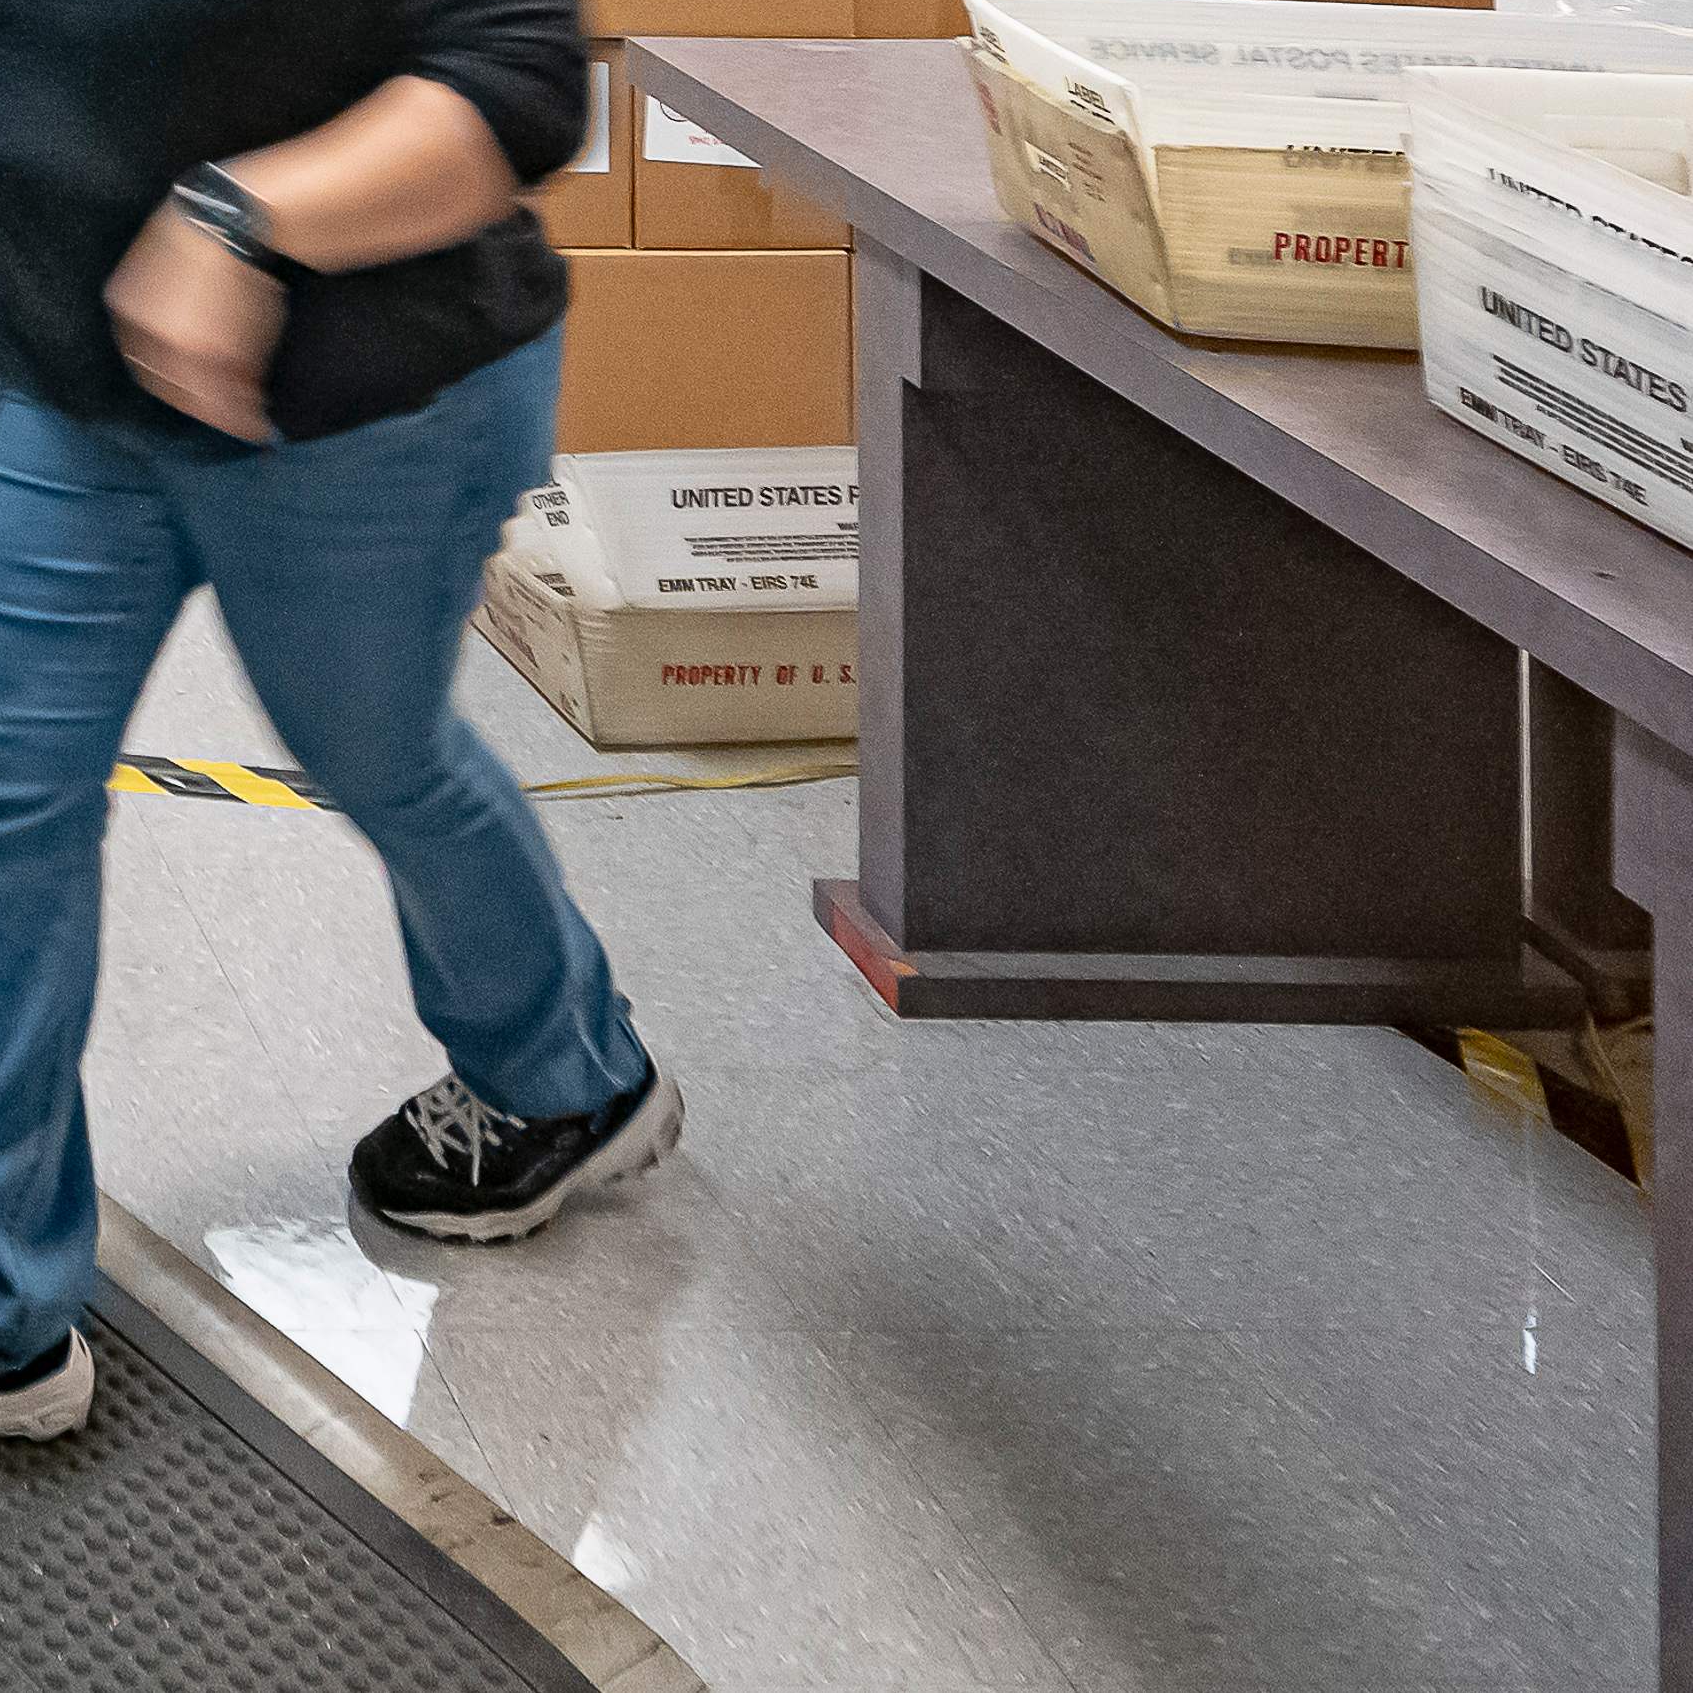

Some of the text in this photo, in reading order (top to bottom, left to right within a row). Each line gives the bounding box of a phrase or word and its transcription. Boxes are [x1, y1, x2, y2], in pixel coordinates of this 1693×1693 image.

[1274, 232, 1410, 268] PROPERT
[1480, 285, 1572, 353] UNITED
[1580, 338, 1688, 412] STATES
[532, 490, 571, 510] OTHER
[672, 485, 859, 509] UNITED STATES P
[545, 510, 570, 527] END
[658, 578, 695, 593] EMM
[696, 577, 737, 592] TRAY
[749, 575, 788, 591] EIRS
[661, 663, 857, 686] PROPERTY OF U. S.
